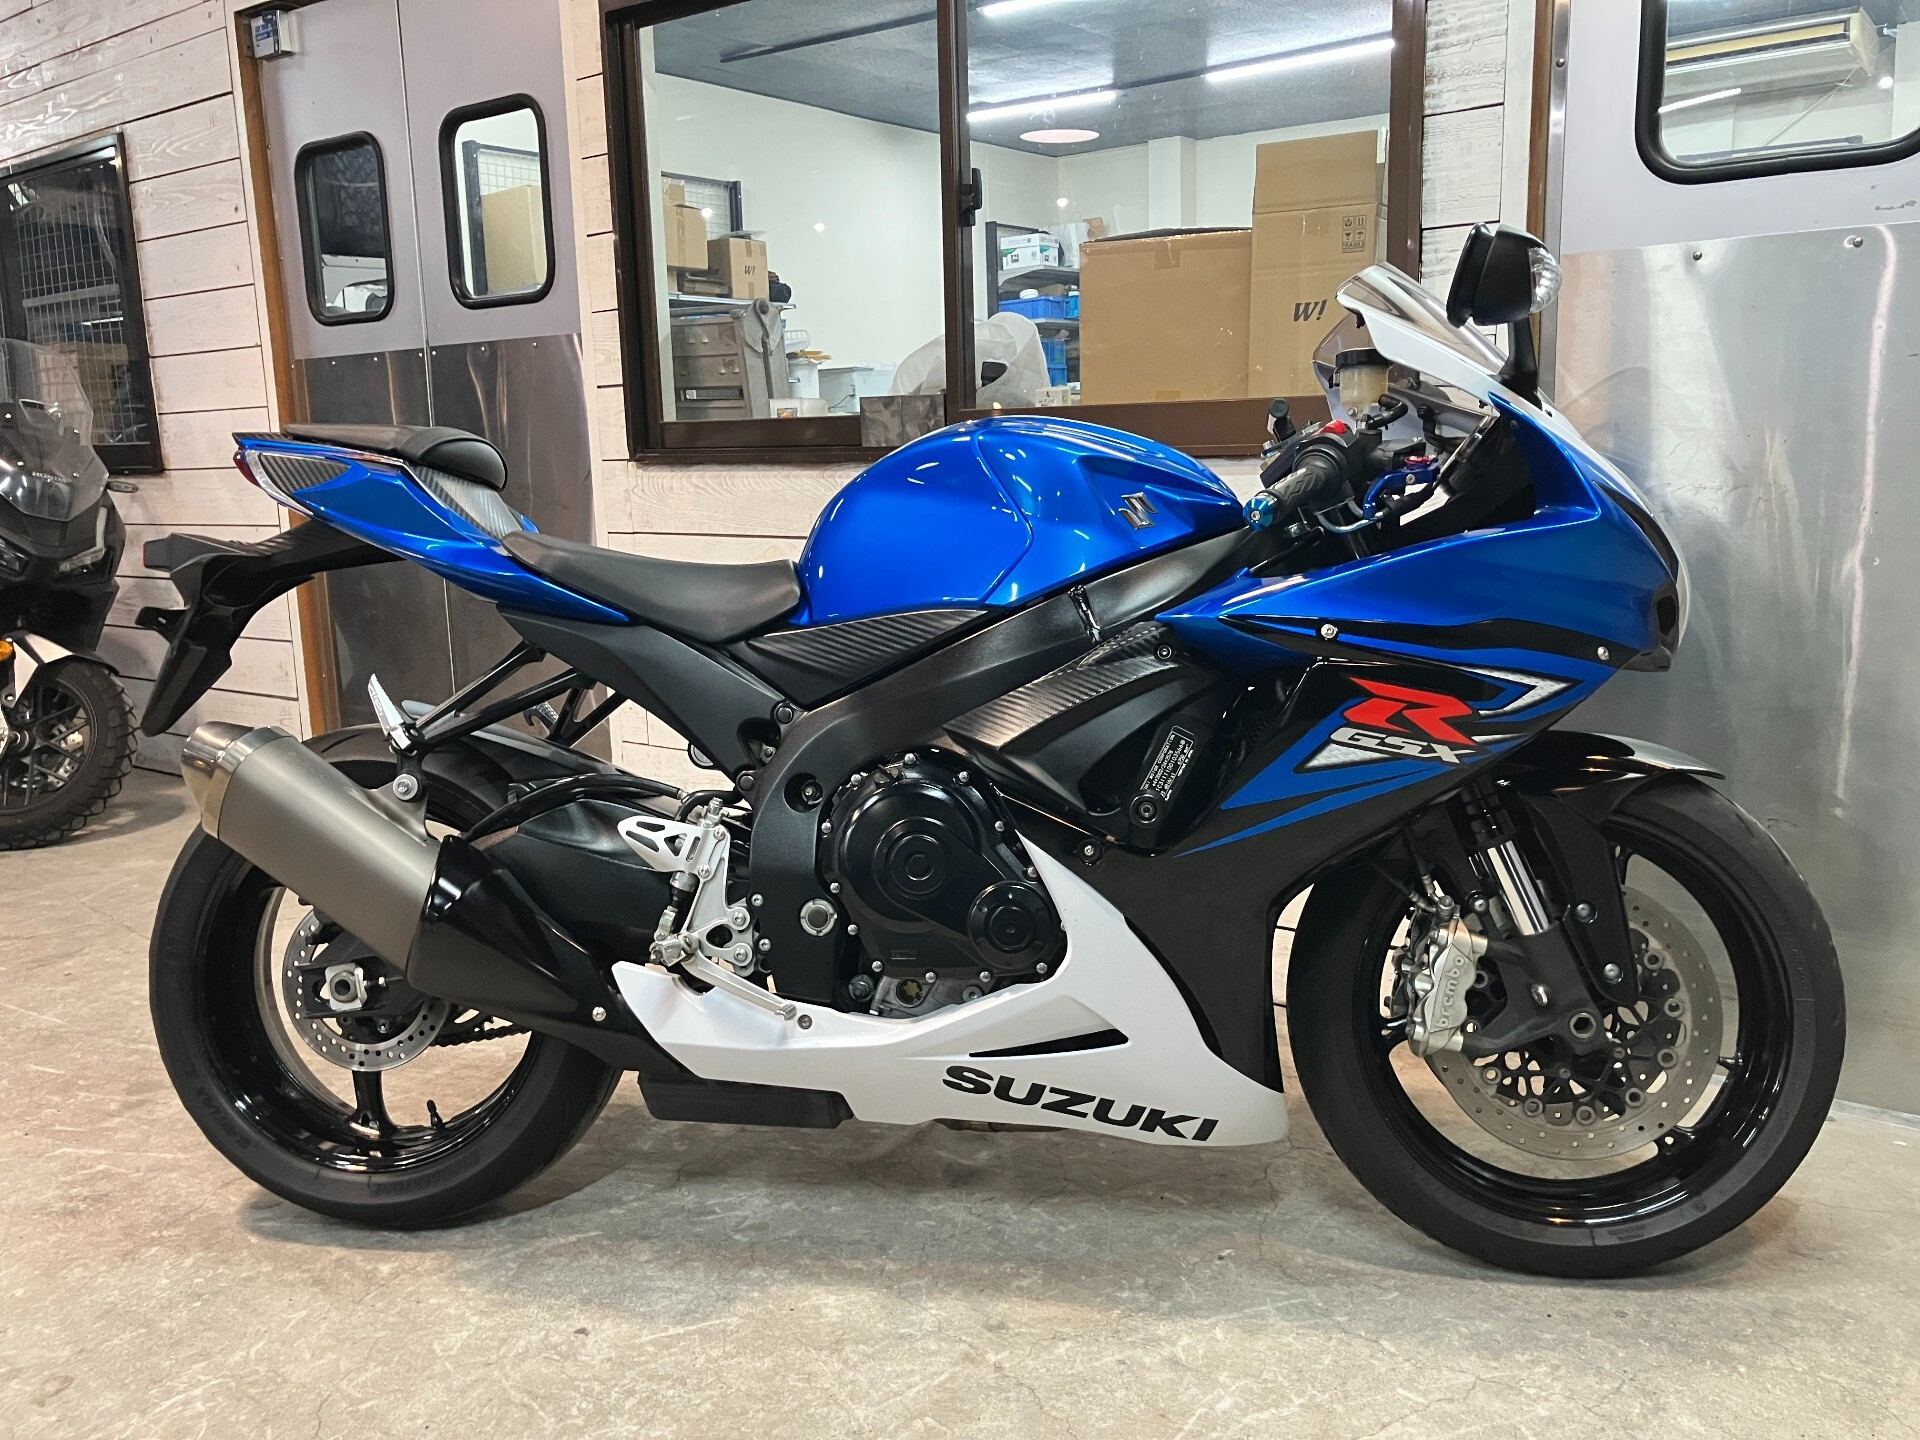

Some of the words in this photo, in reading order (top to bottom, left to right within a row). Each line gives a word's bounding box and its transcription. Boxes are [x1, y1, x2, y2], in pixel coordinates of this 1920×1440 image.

[1342, 241, 1365, 249] FRAGILE
[1293, 299, 1328, 322] W!
[1330, 727, 1477, 764] GSX
[1434, 955, 1465, 1028] brembo
[942, 1065, 1219, 1142] SUZUKI
